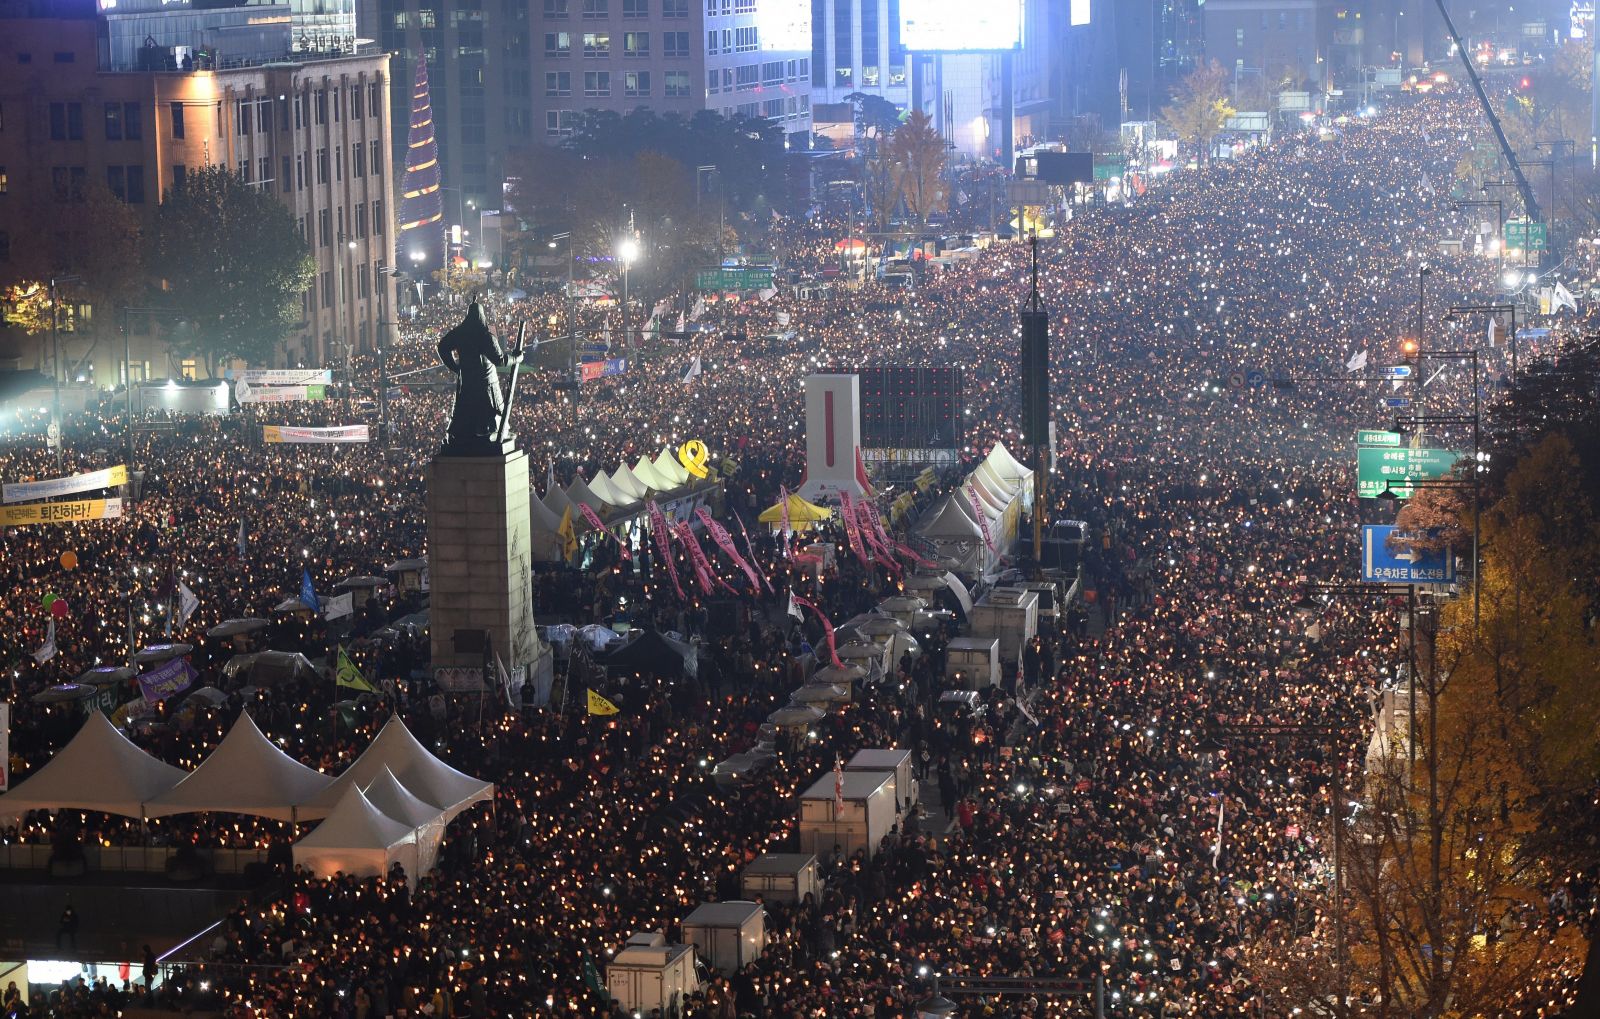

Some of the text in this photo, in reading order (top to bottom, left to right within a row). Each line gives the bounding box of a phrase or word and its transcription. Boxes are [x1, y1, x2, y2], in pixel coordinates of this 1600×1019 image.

[1383, 452, 1405, 461] 숭례문
[1391, 466, 1406, 474] 시청
[6, 503, 91, 520] 박근혜는 퇴진하라!
[1374, 567, 1444, 580] 우측차로 버스전용
